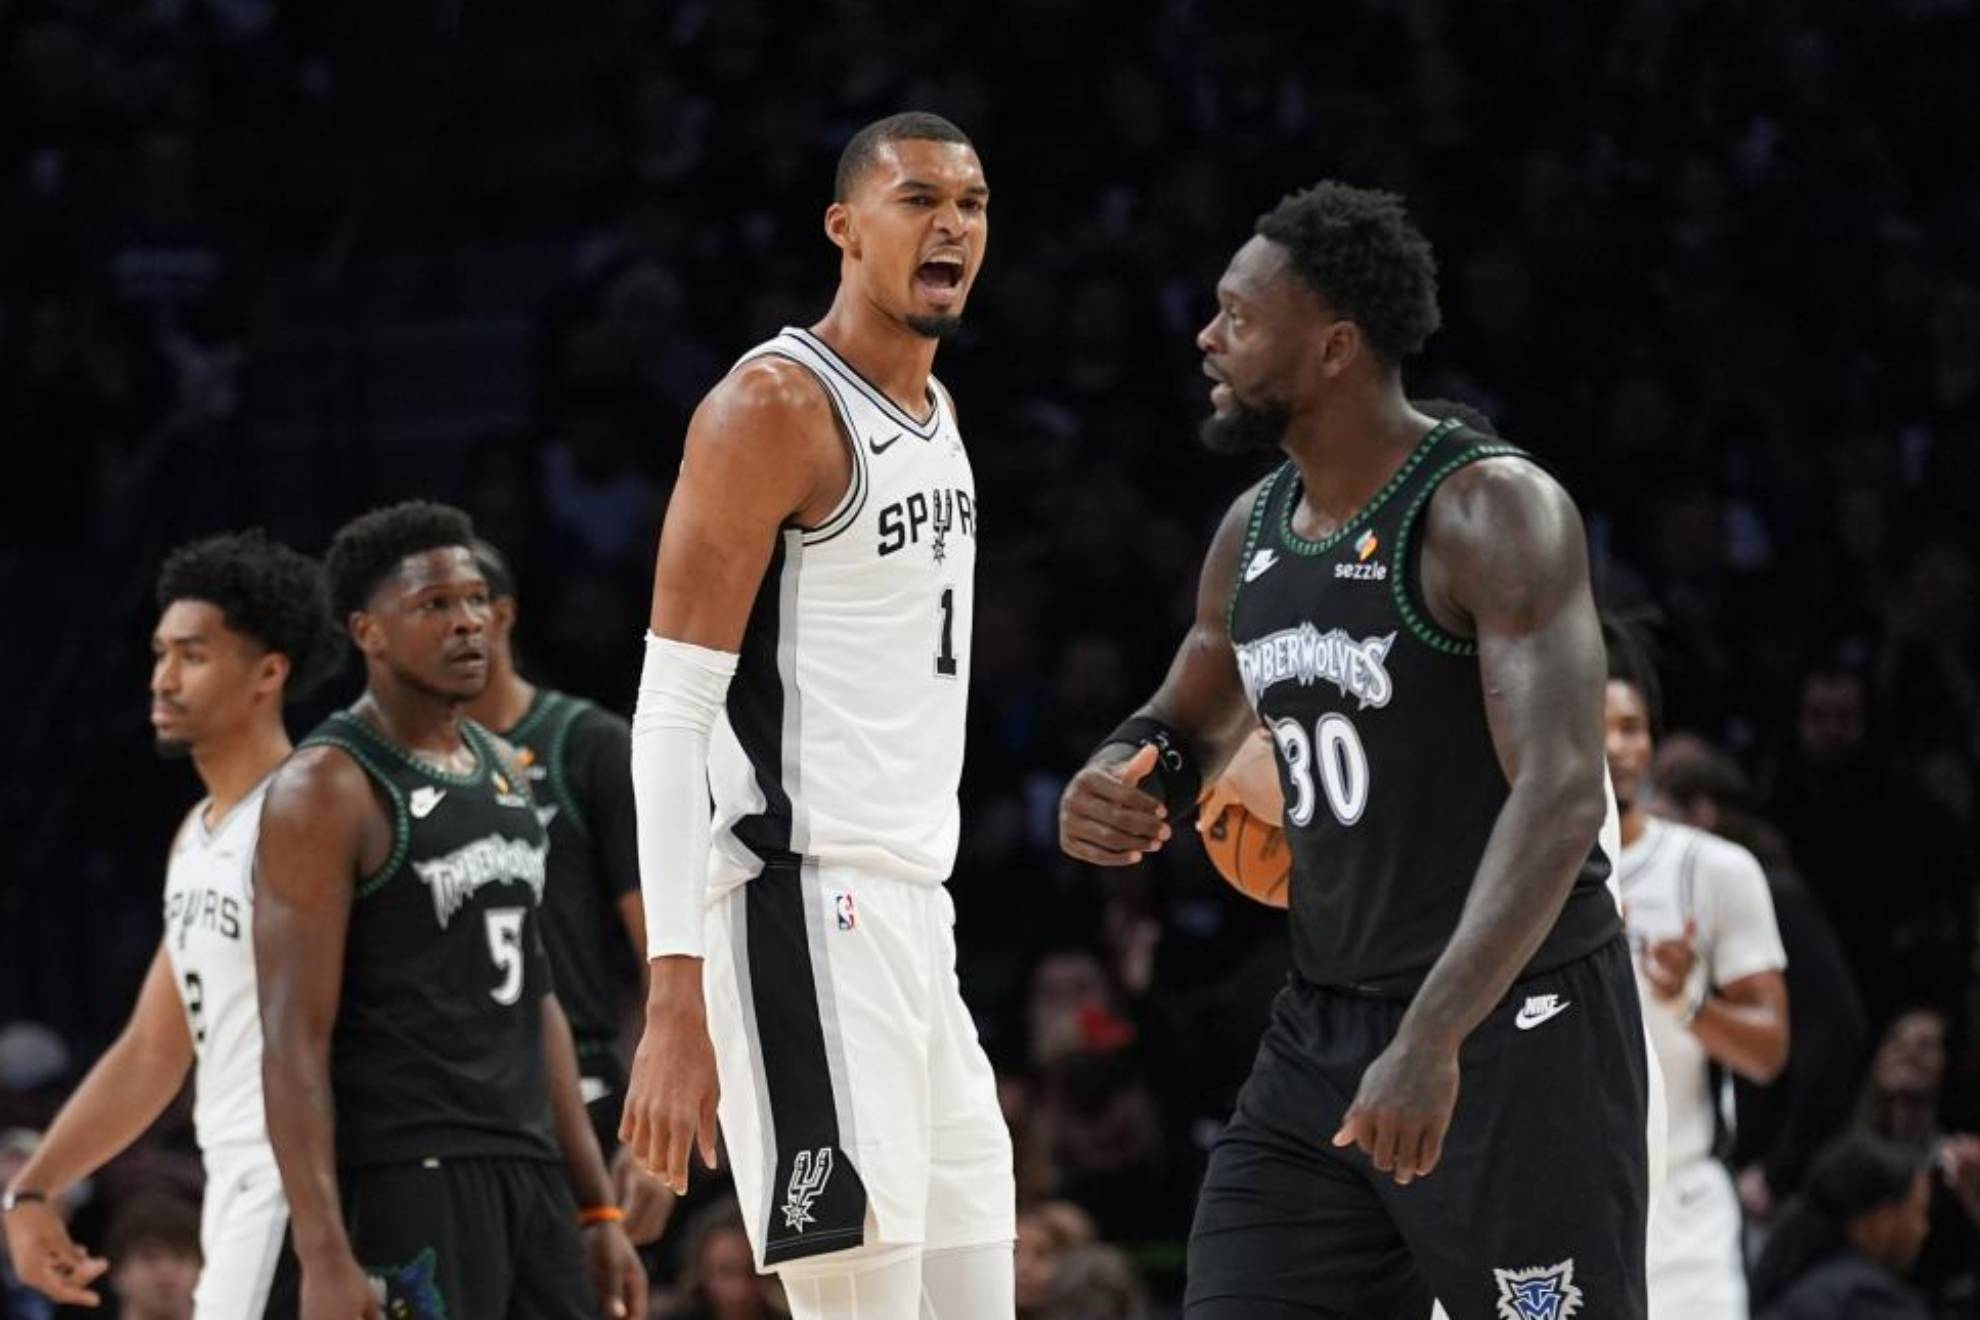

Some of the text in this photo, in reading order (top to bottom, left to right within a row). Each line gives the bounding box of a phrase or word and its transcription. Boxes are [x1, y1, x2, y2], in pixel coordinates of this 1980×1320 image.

[1333, 561, 1388, 581] sezzle
[934, 585, 957, 678] 1
[1265, 711, 1371, 828] 30
[484, 905, 527, 1006] 5
